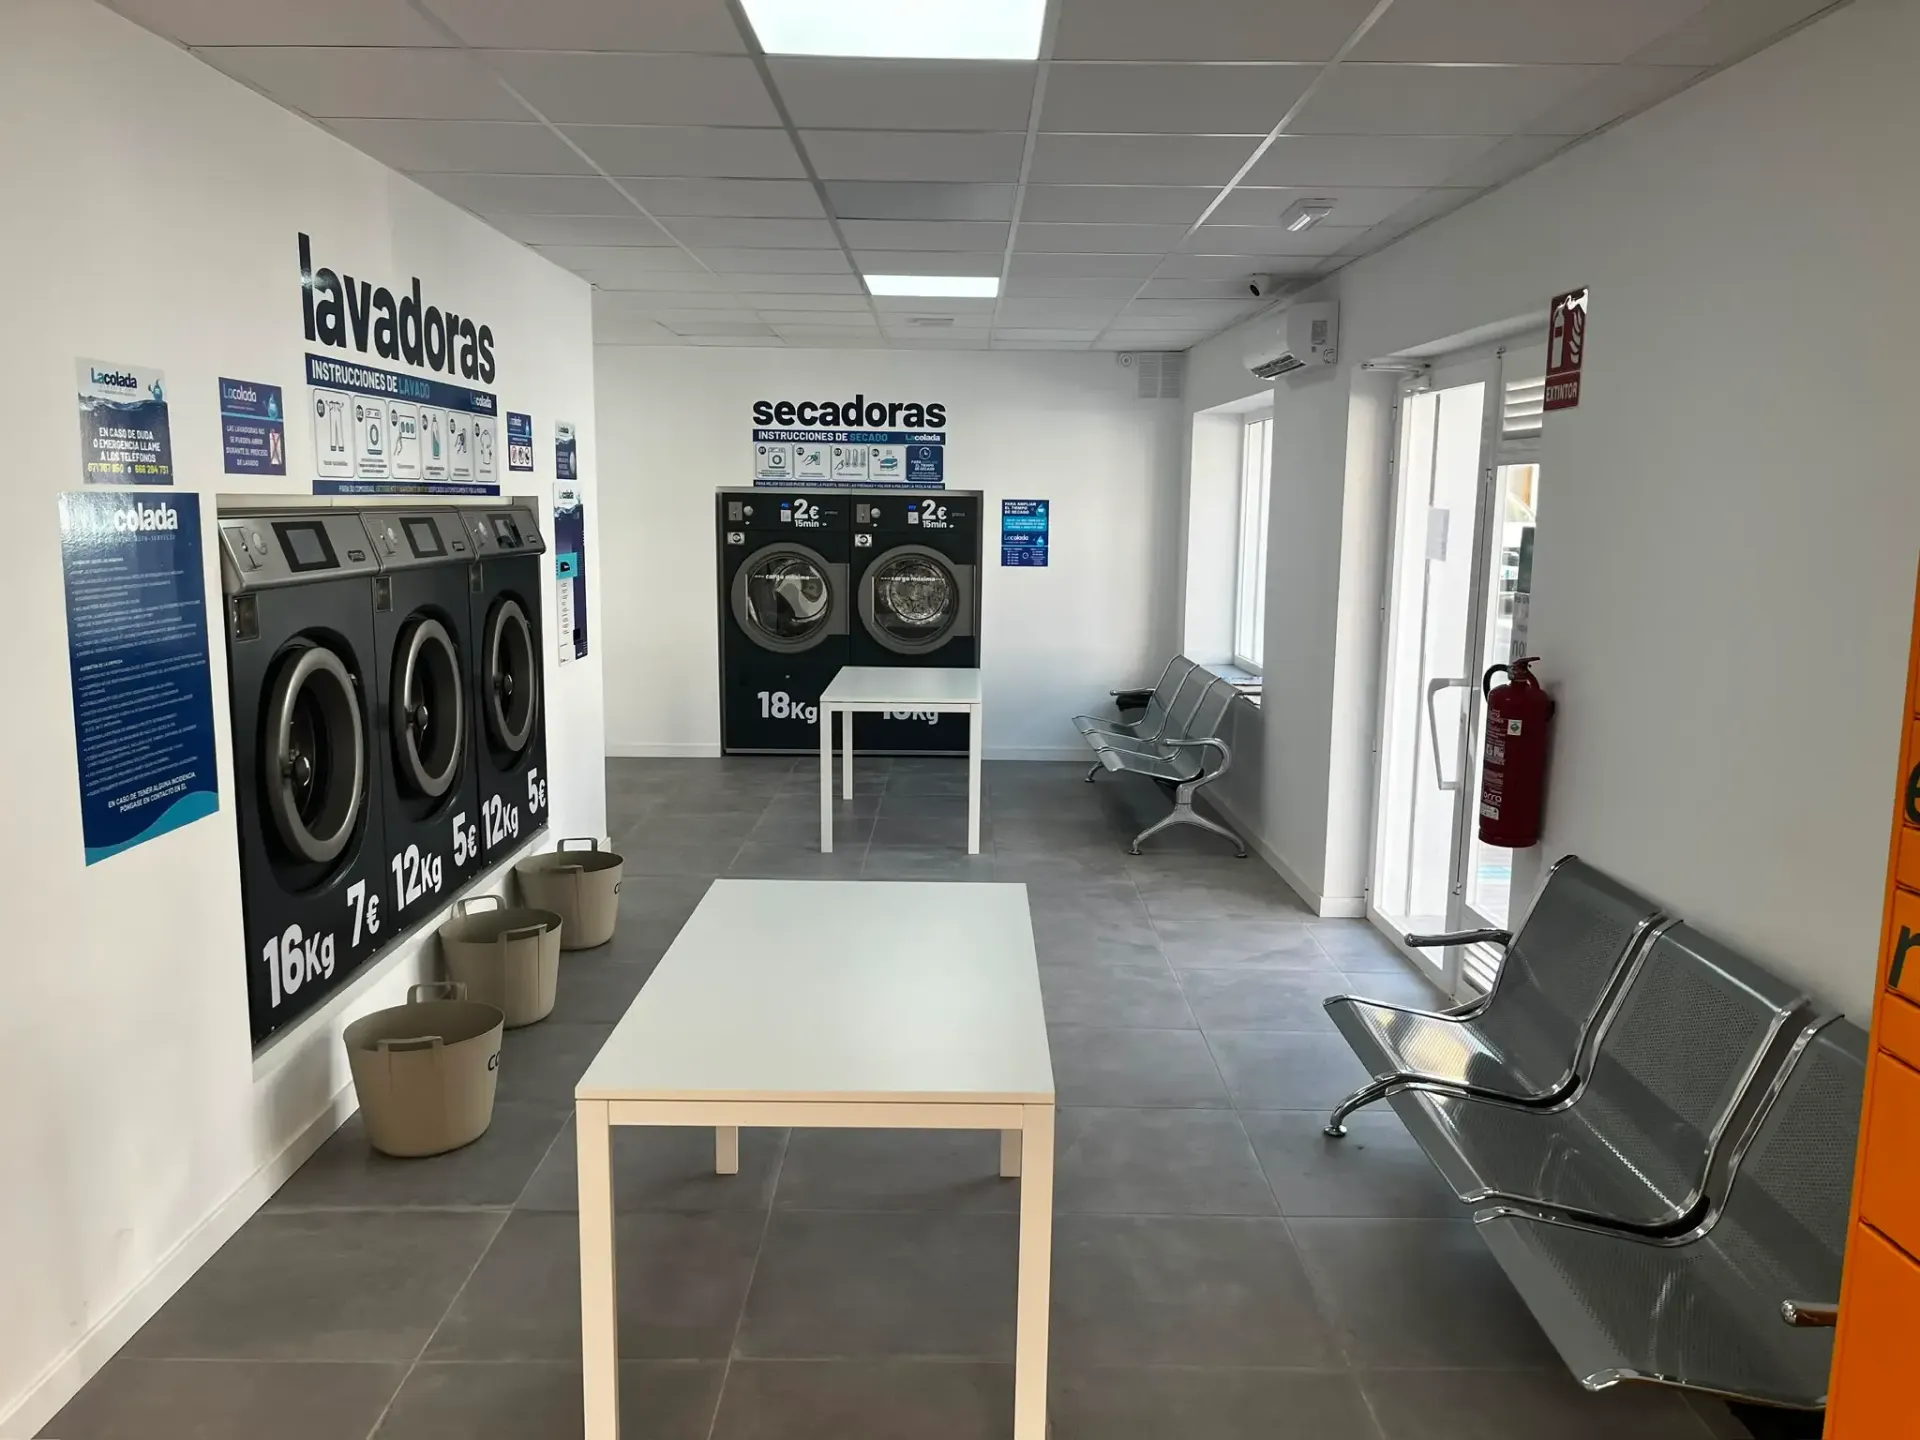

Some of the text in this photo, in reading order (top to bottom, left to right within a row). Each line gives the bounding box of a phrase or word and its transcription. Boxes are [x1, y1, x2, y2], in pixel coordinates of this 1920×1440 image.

[298, 232, 495, 384] lavadoras
[91, 367, 137, 388] Lacolada
[312, 360, 430, 399] INSTRUCCIONES DE LAVADO
[223, 382, 256, 402] Lacolada
[1546, 382, 1577, 402] EXTINTOR
[753, 394, 946, 428] secadoras
[99, 427, 153, 440] EN CASO DE DUDA
[758, 431, 888, 442] INSTRUCCIONES DE SECADO
[99, 440, 139, 450] EMERGENCIA
[141, 442, 161, 452] LLAME
[100, 451, 106, 461] A
[107, 451, 120, 461] LOS
[114, 502, 178, 532] colada
[794, 498, 820, 519] 2€
[922, 500, 947, 520] 2€
[794, 519, 820, 528] 15min
[922, 520, 947, 528] 15min
[758, 692, 818, 724] 18Kg
[482, 768, 546, 850] 12Kg 5€
[392, 812, 477, 912] 12Kg 5€
[262, 878, 380, 1008] 16Kg 7€
